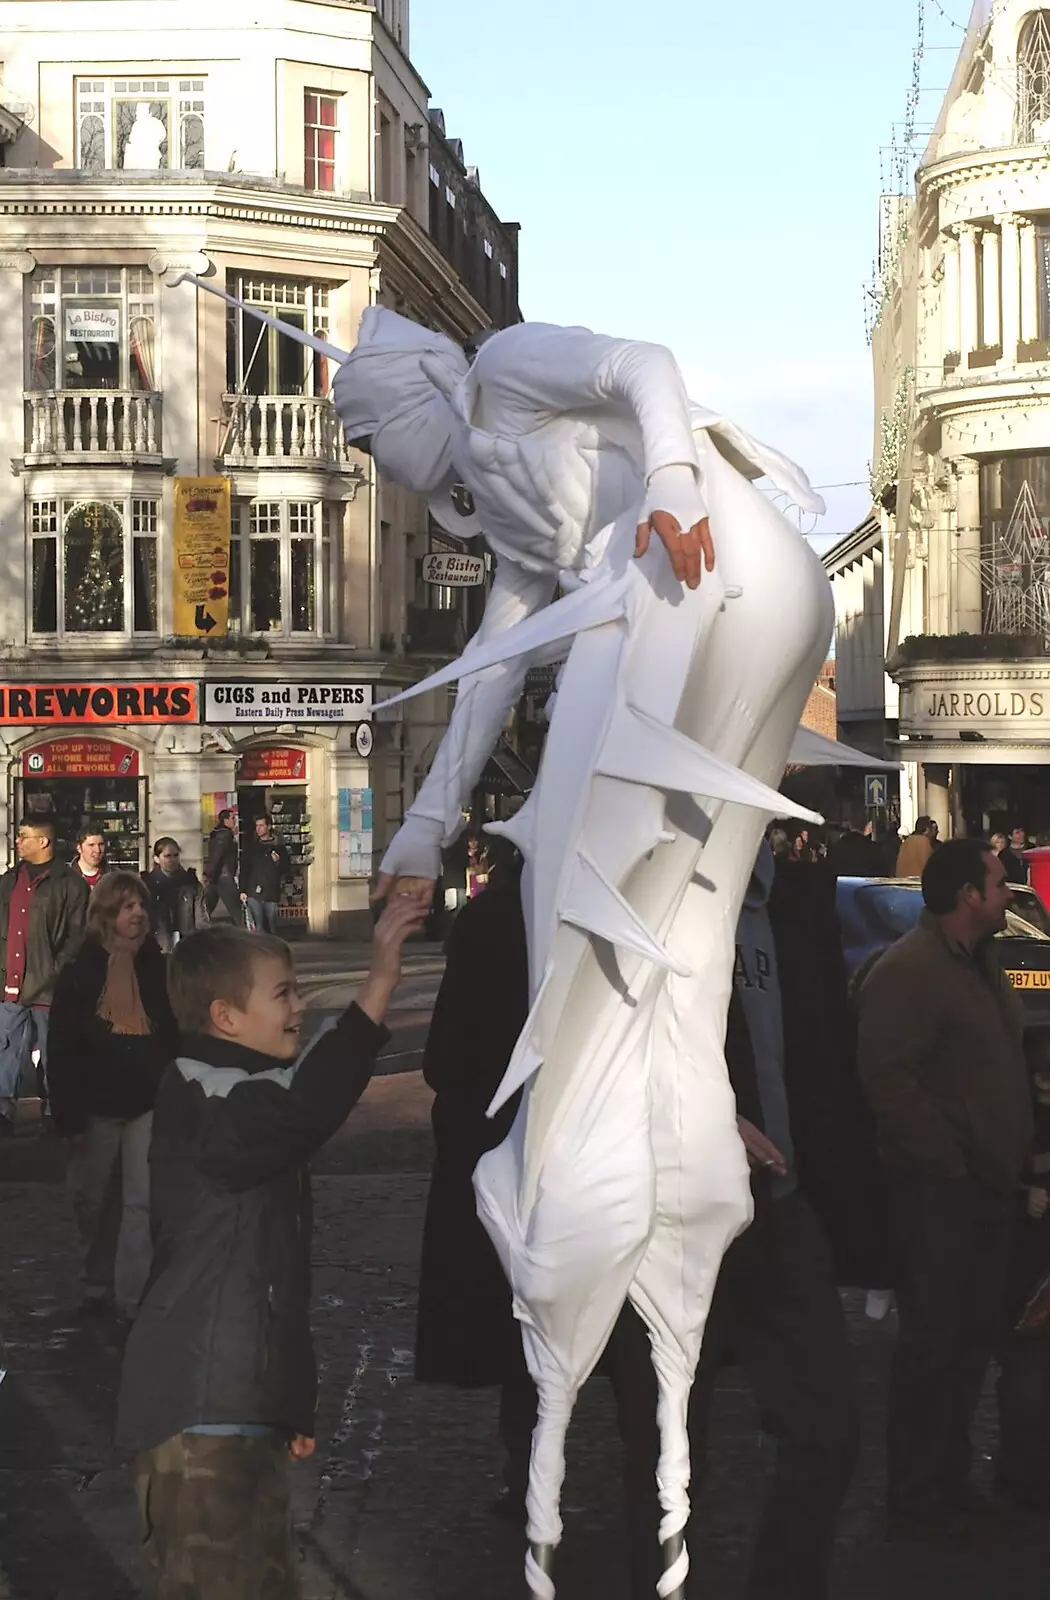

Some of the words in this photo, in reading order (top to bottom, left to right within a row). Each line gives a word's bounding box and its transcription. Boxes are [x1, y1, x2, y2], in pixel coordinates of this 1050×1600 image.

[67, 315, 82, 326] Le
[84, 310, 117, 327] Bistro
[69, 329, 115, 338] RESTAURANT
[427, 556, 443, 570] Le
[446, 557, 481, 572] Bistro
[427, 569, 479, 583] Restaurant
[213, 687, 255, 704] CIGS
[261, 687, 291, 704] and
[297, 687, 365, 705] PAPERS
[928, 693, 1044, 716] JARROLDS
[235, 707, 263, 717] Eastern
[265, 707, 284, 718] Daily
[286, 707, 305, 717] Press
[306, 707, 344, 718] Newsagent
[50, 744, 68, 753] TOP
[71, 744, 84, 753] UP
[87, 744, 112, 753] YOUR
[51, 754, 82, 763] PHONE
[86, 754, 111, 763] HERE
[46, 764, 63, 773] ALL
[66, 763, 116, 772] NETWORKS
